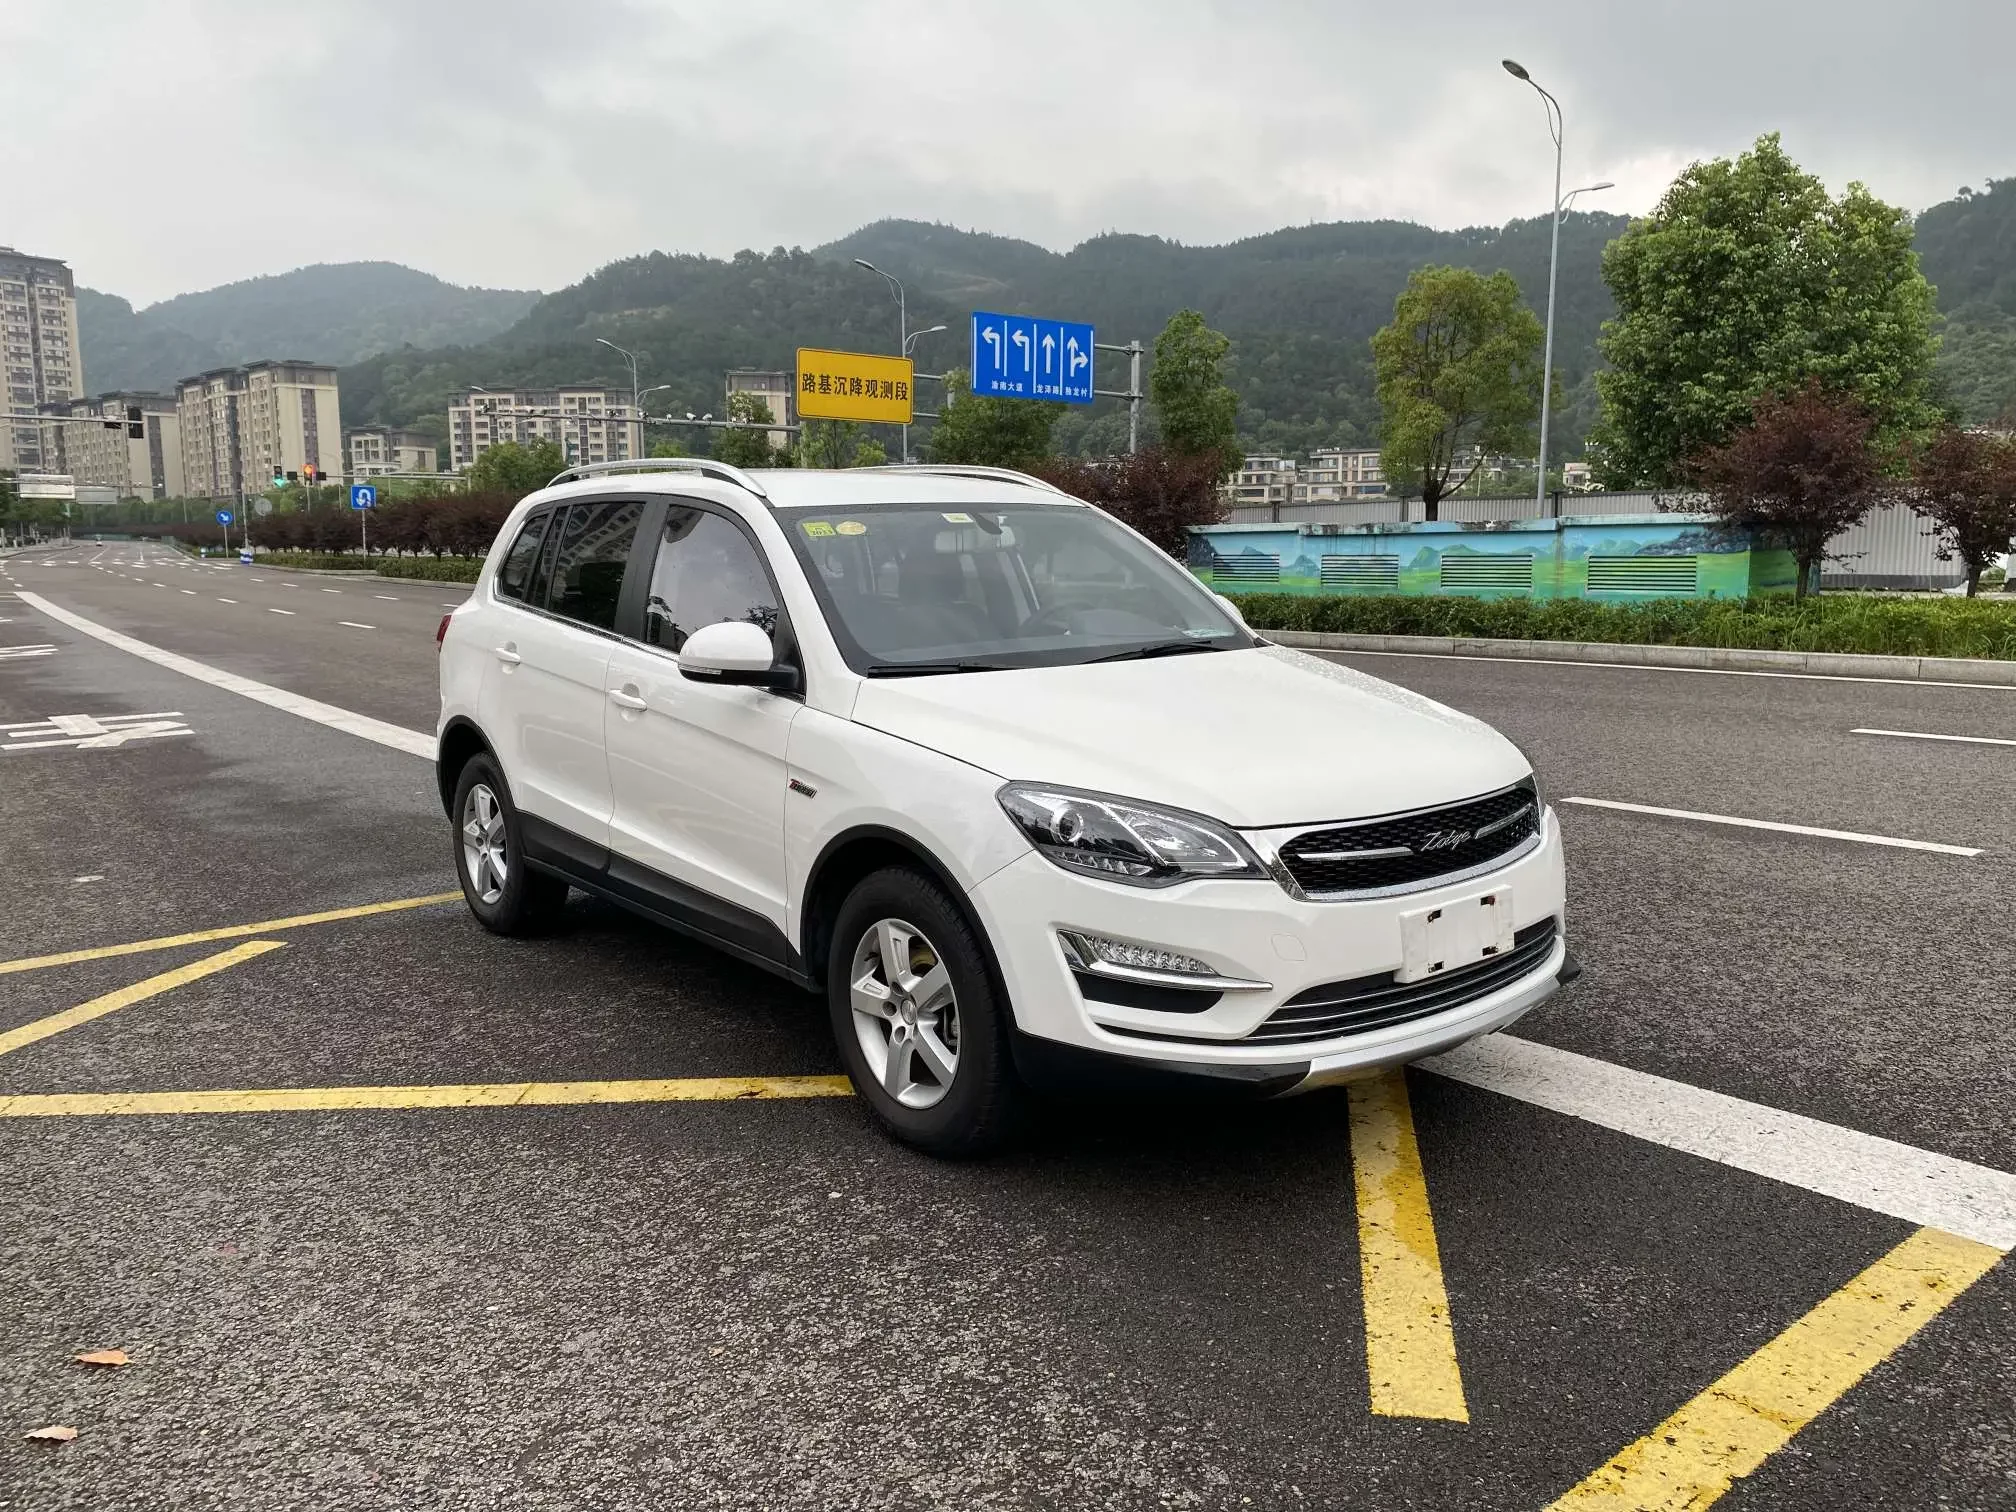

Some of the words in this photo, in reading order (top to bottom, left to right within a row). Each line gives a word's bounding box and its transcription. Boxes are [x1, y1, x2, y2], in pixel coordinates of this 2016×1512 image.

[802, 373, 908, 400] 路基沉降观测段
[1420, 829, 1471, 852] Zotye
